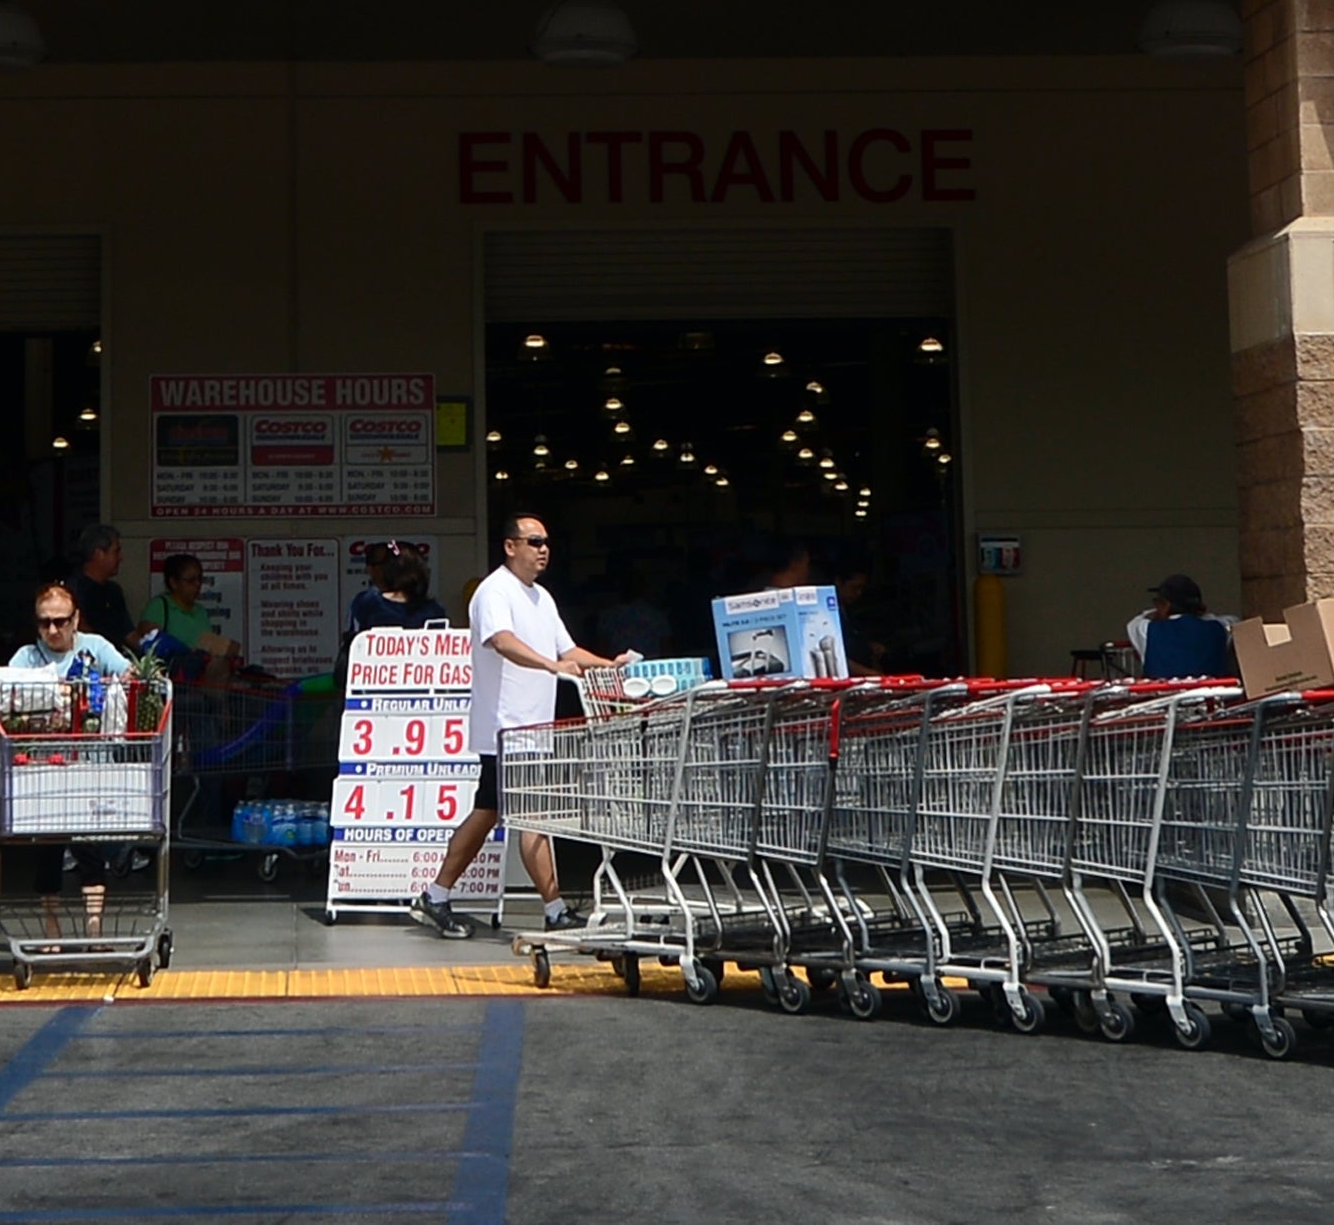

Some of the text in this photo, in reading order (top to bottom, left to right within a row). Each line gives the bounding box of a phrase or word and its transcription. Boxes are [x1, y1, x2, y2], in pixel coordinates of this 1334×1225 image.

[459, 128, 976, 203] ENTRANCE
[160, 377, 425, 407] WAREHOUSE HOURS
[156, 507, 189, 515] OPEN
[194, 507, 207, 515] 24
[212, 507, 253, 515] HOURS
[270, 506, 293, 515] DAY
[299, 506, 312, 514] AT
[317, 506, 431, 514] WWW.COSTCO.COM
[251, 543, 282, 557] Thank
[286, 543, 304, 557] You
[307, 543, 335, 557] For...
[261, 564, 312, 573] Keeping your
[261, 573, 328, 582] children with you
[261, 600, 319, 609] Wearing shoes
[261, 620, 297, 628] shopping
[261, 645, 295, 654] Allowing
[366, 634, 430, 656] TODAY'S
[351, 663, 397, 684] PRICE
[403, 663, 434, 684] FOR
[373, 699, 429, 712] REGULAR
[367, 763, 424, 776] PREMIUM
[344, 828, 392, 842] HOURS
[395, 828, 415, 842] OF
[334, 849, 356, 862] Mon
[413, 851, 438, 863] 6:00
[488, 853, 501, 863] PM
[411, 867, 437, 878] 6:00
[487, 868, 500, 878] PM
[460, 881, 484, 893] 7:00
[486, 883, 499, 893] PM
